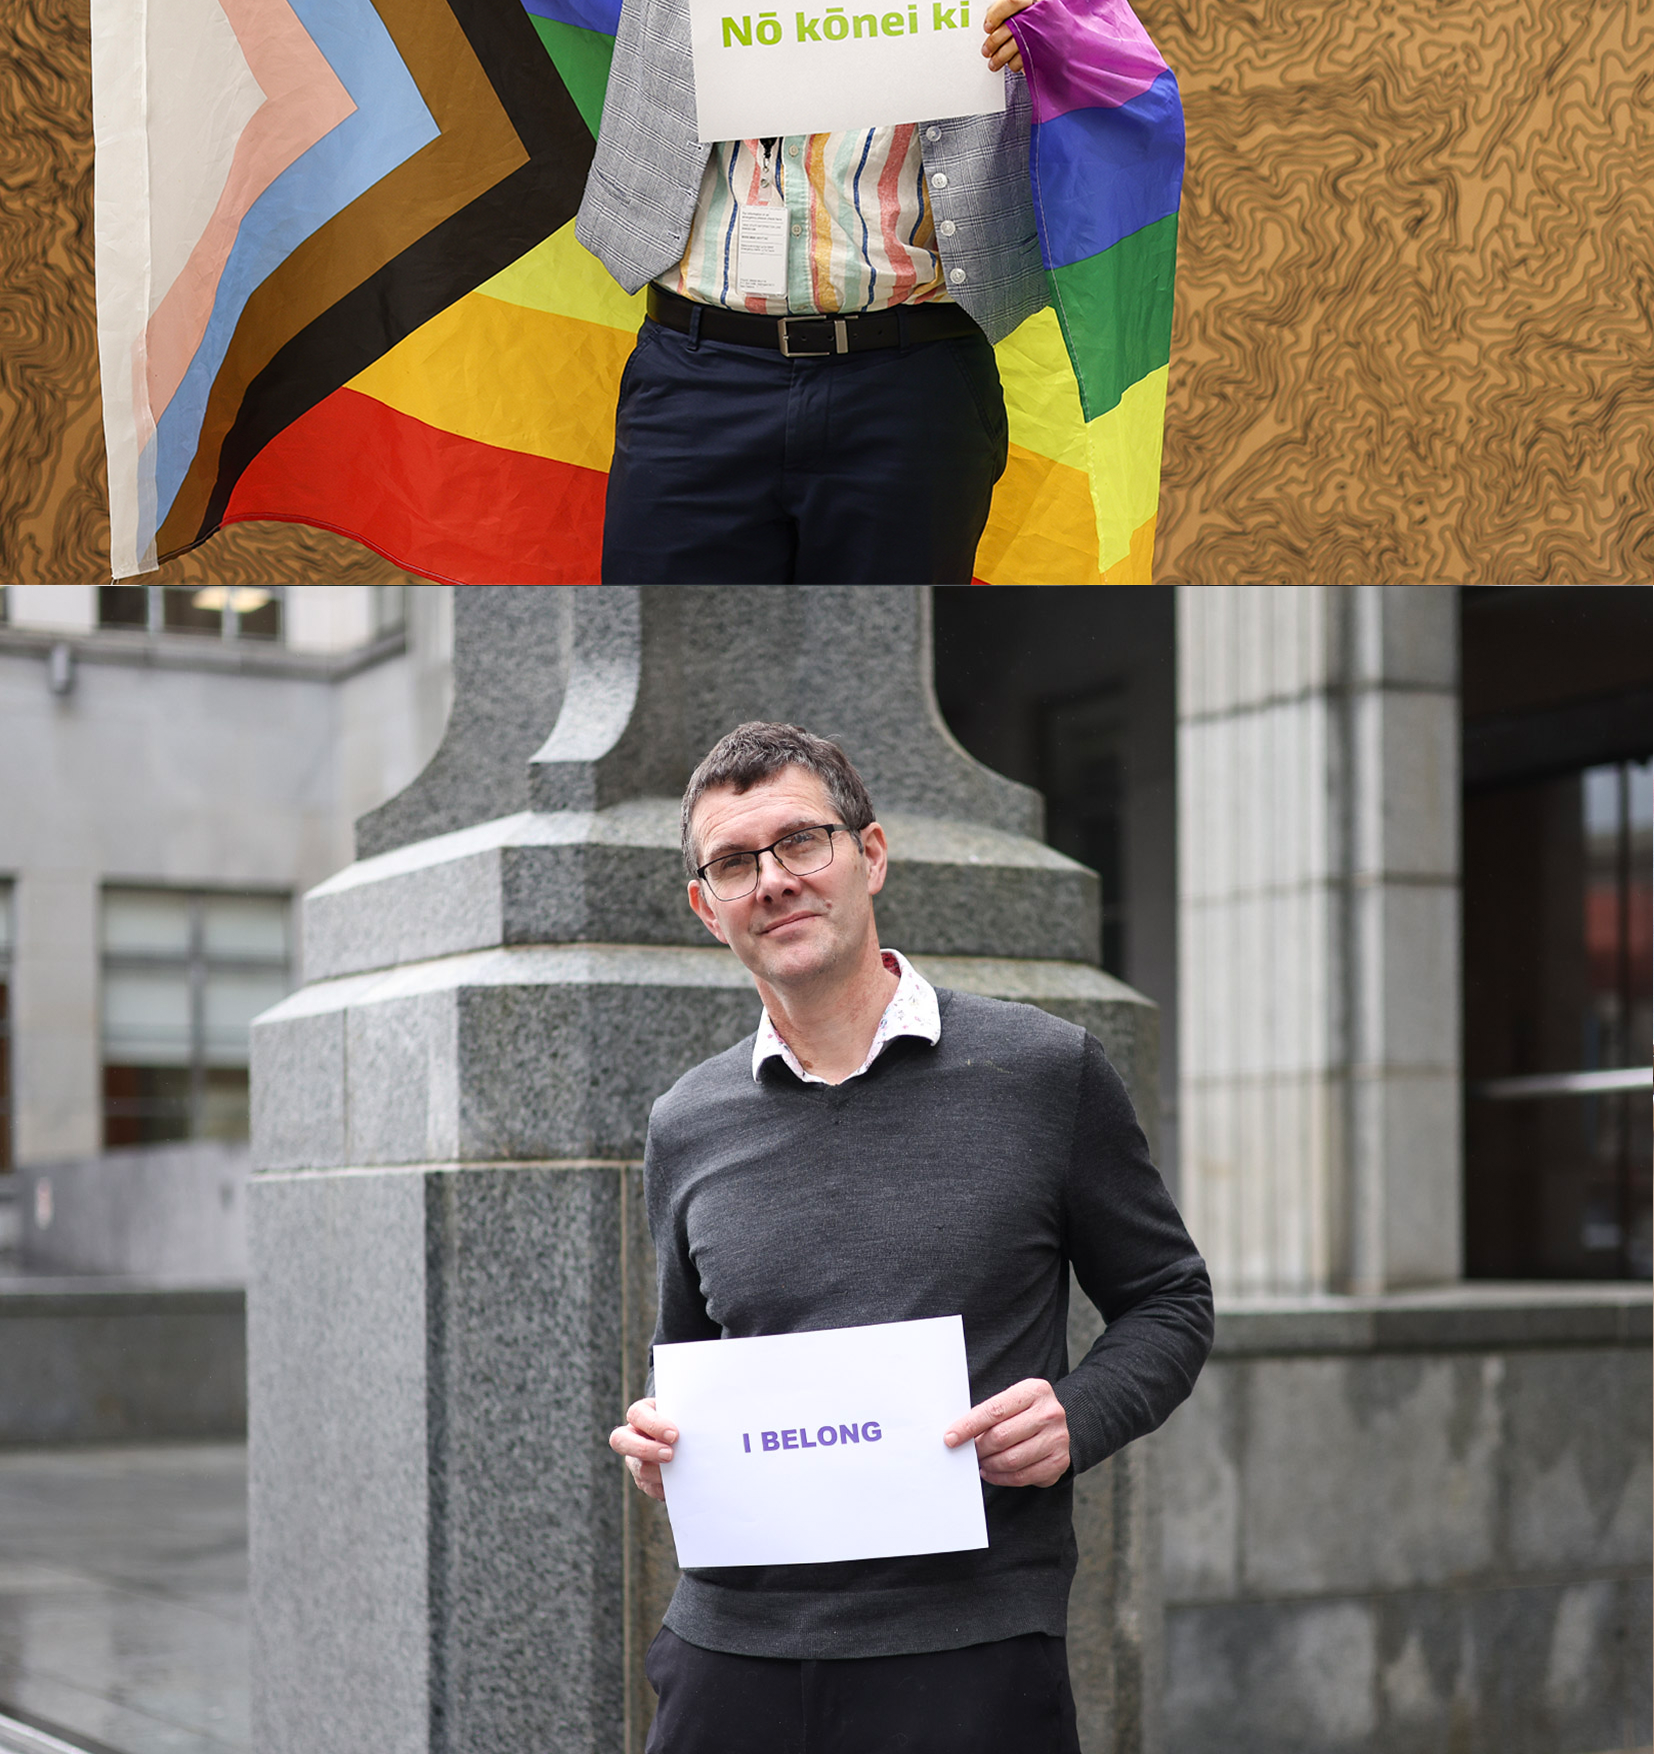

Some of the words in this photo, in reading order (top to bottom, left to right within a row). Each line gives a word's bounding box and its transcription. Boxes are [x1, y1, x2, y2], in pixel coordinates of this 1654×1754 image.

[721, 11, 783, 48] Nō
[795, 4, 918, 43] kōnei
[932, 0, 970, 31] ki
[742, 1432, 753, 1454] I
[760, 1421, 883, 1453] BELONG
